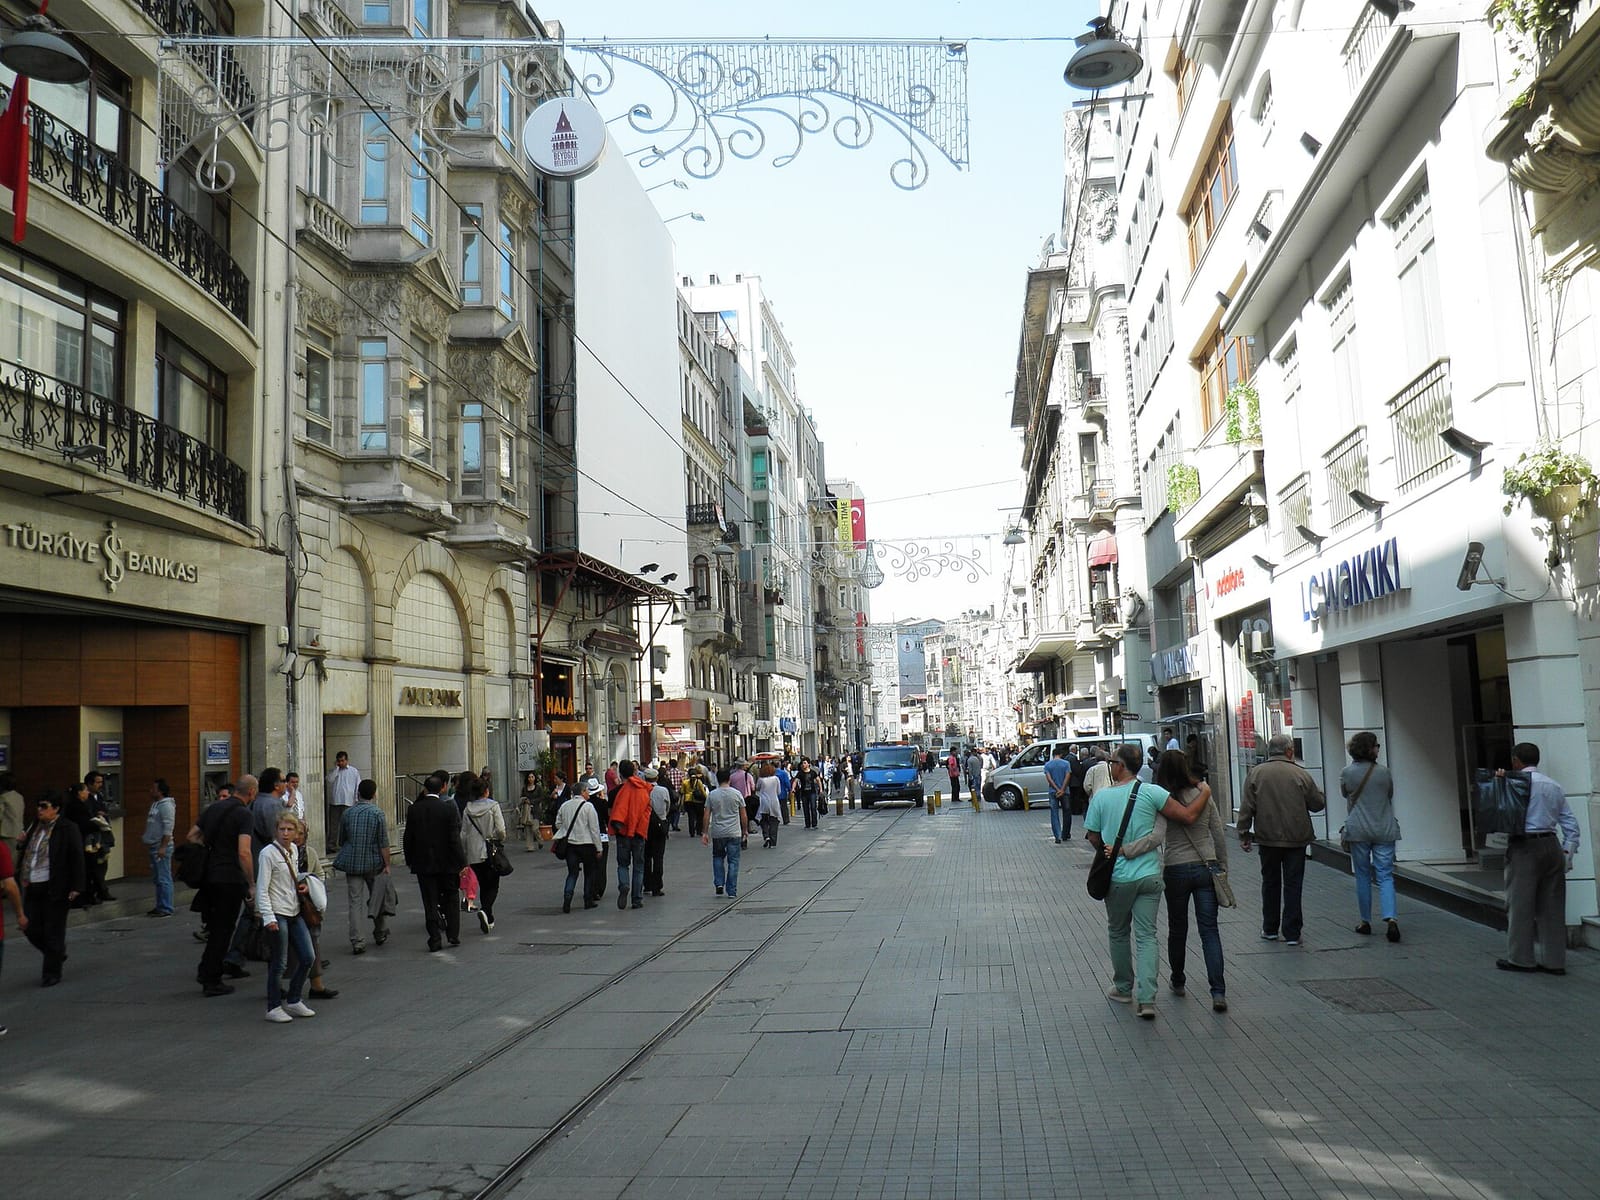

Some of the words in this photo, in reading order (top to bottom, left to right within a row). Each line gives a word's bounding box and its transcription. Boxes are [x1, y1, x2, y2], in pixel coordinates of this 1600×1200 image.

[840, 501, 849, 520] TIME
[5, 523, 99, 563] TÜRKİYE
[126, 551, 200, 583] BANKASI
[1300, 574, 1320, 622] LC
